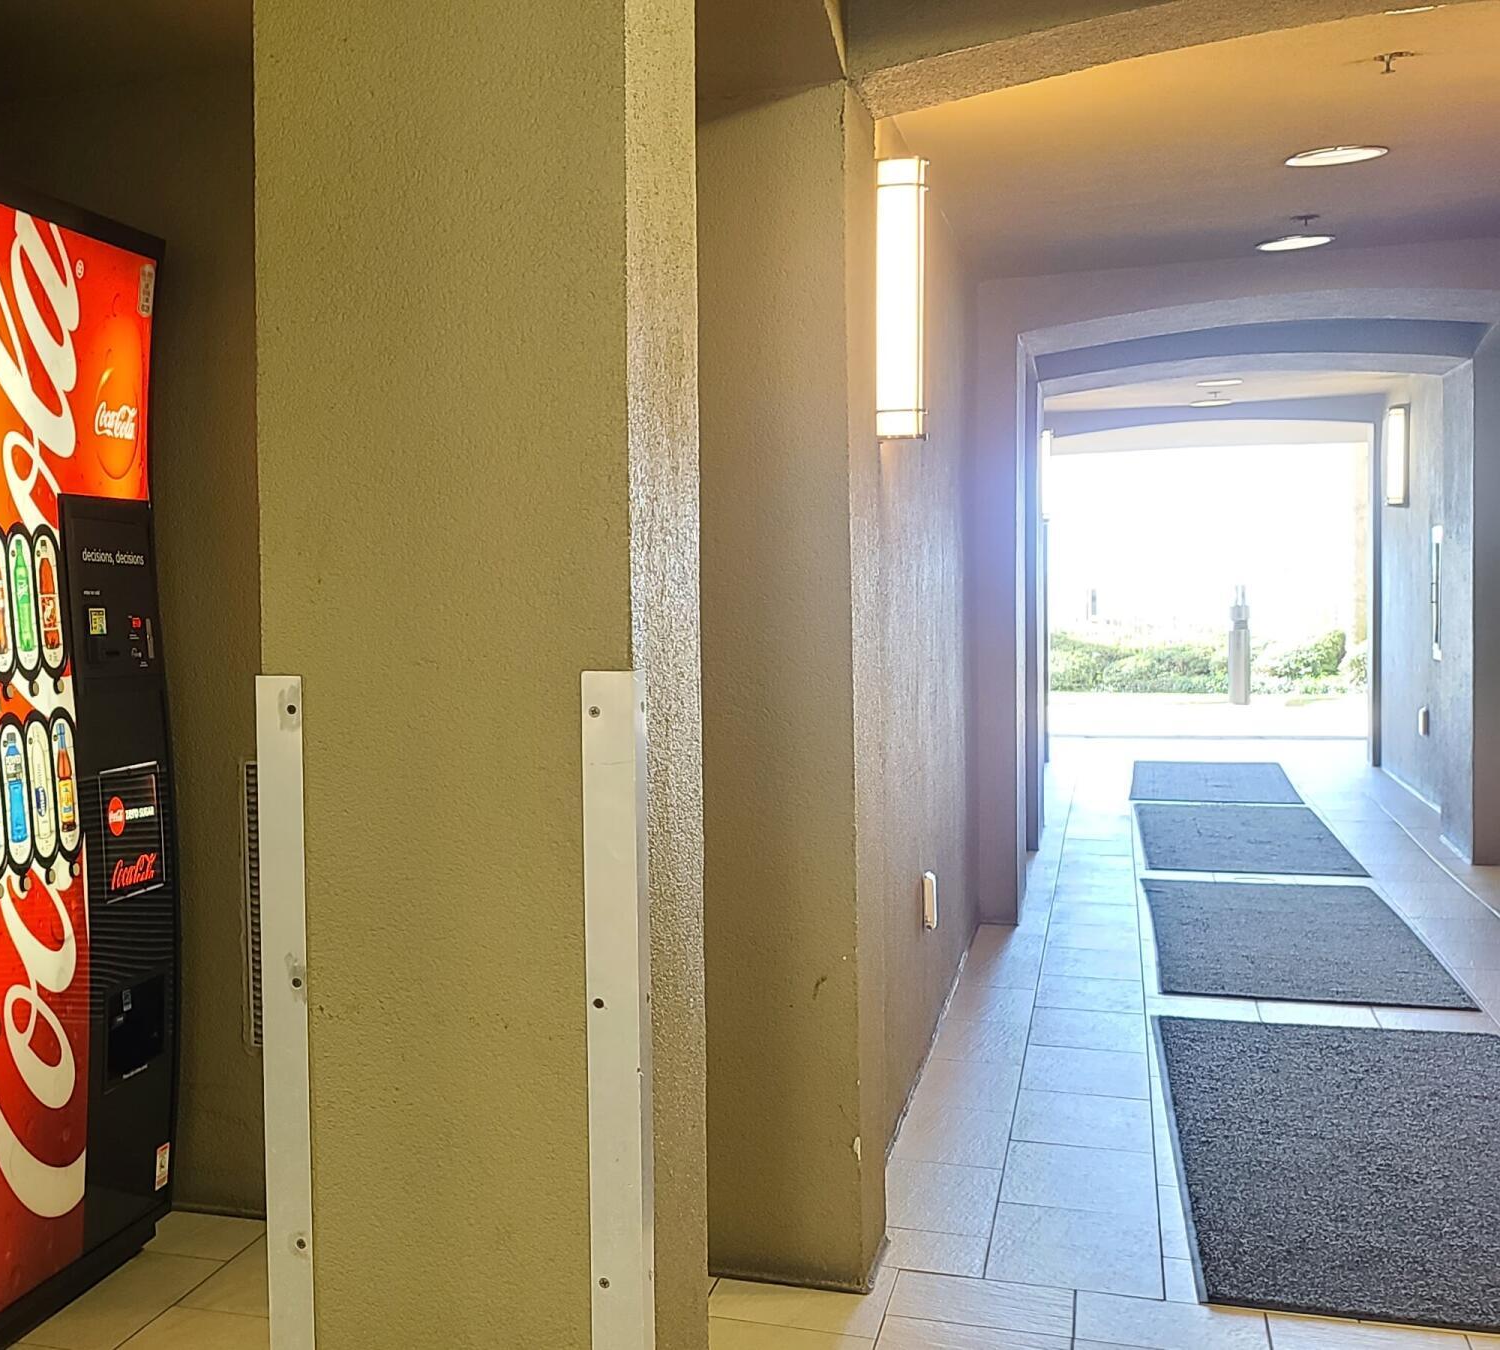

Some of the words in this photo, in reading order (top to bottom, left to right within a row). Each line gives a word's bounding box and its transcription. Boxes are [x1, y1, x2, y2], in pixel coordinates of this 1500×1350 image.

[94, 401, 137, 440] Coca-Cola
[82, 547, 115, 566] decisions,
[115, 550, 145, 566] decisions
